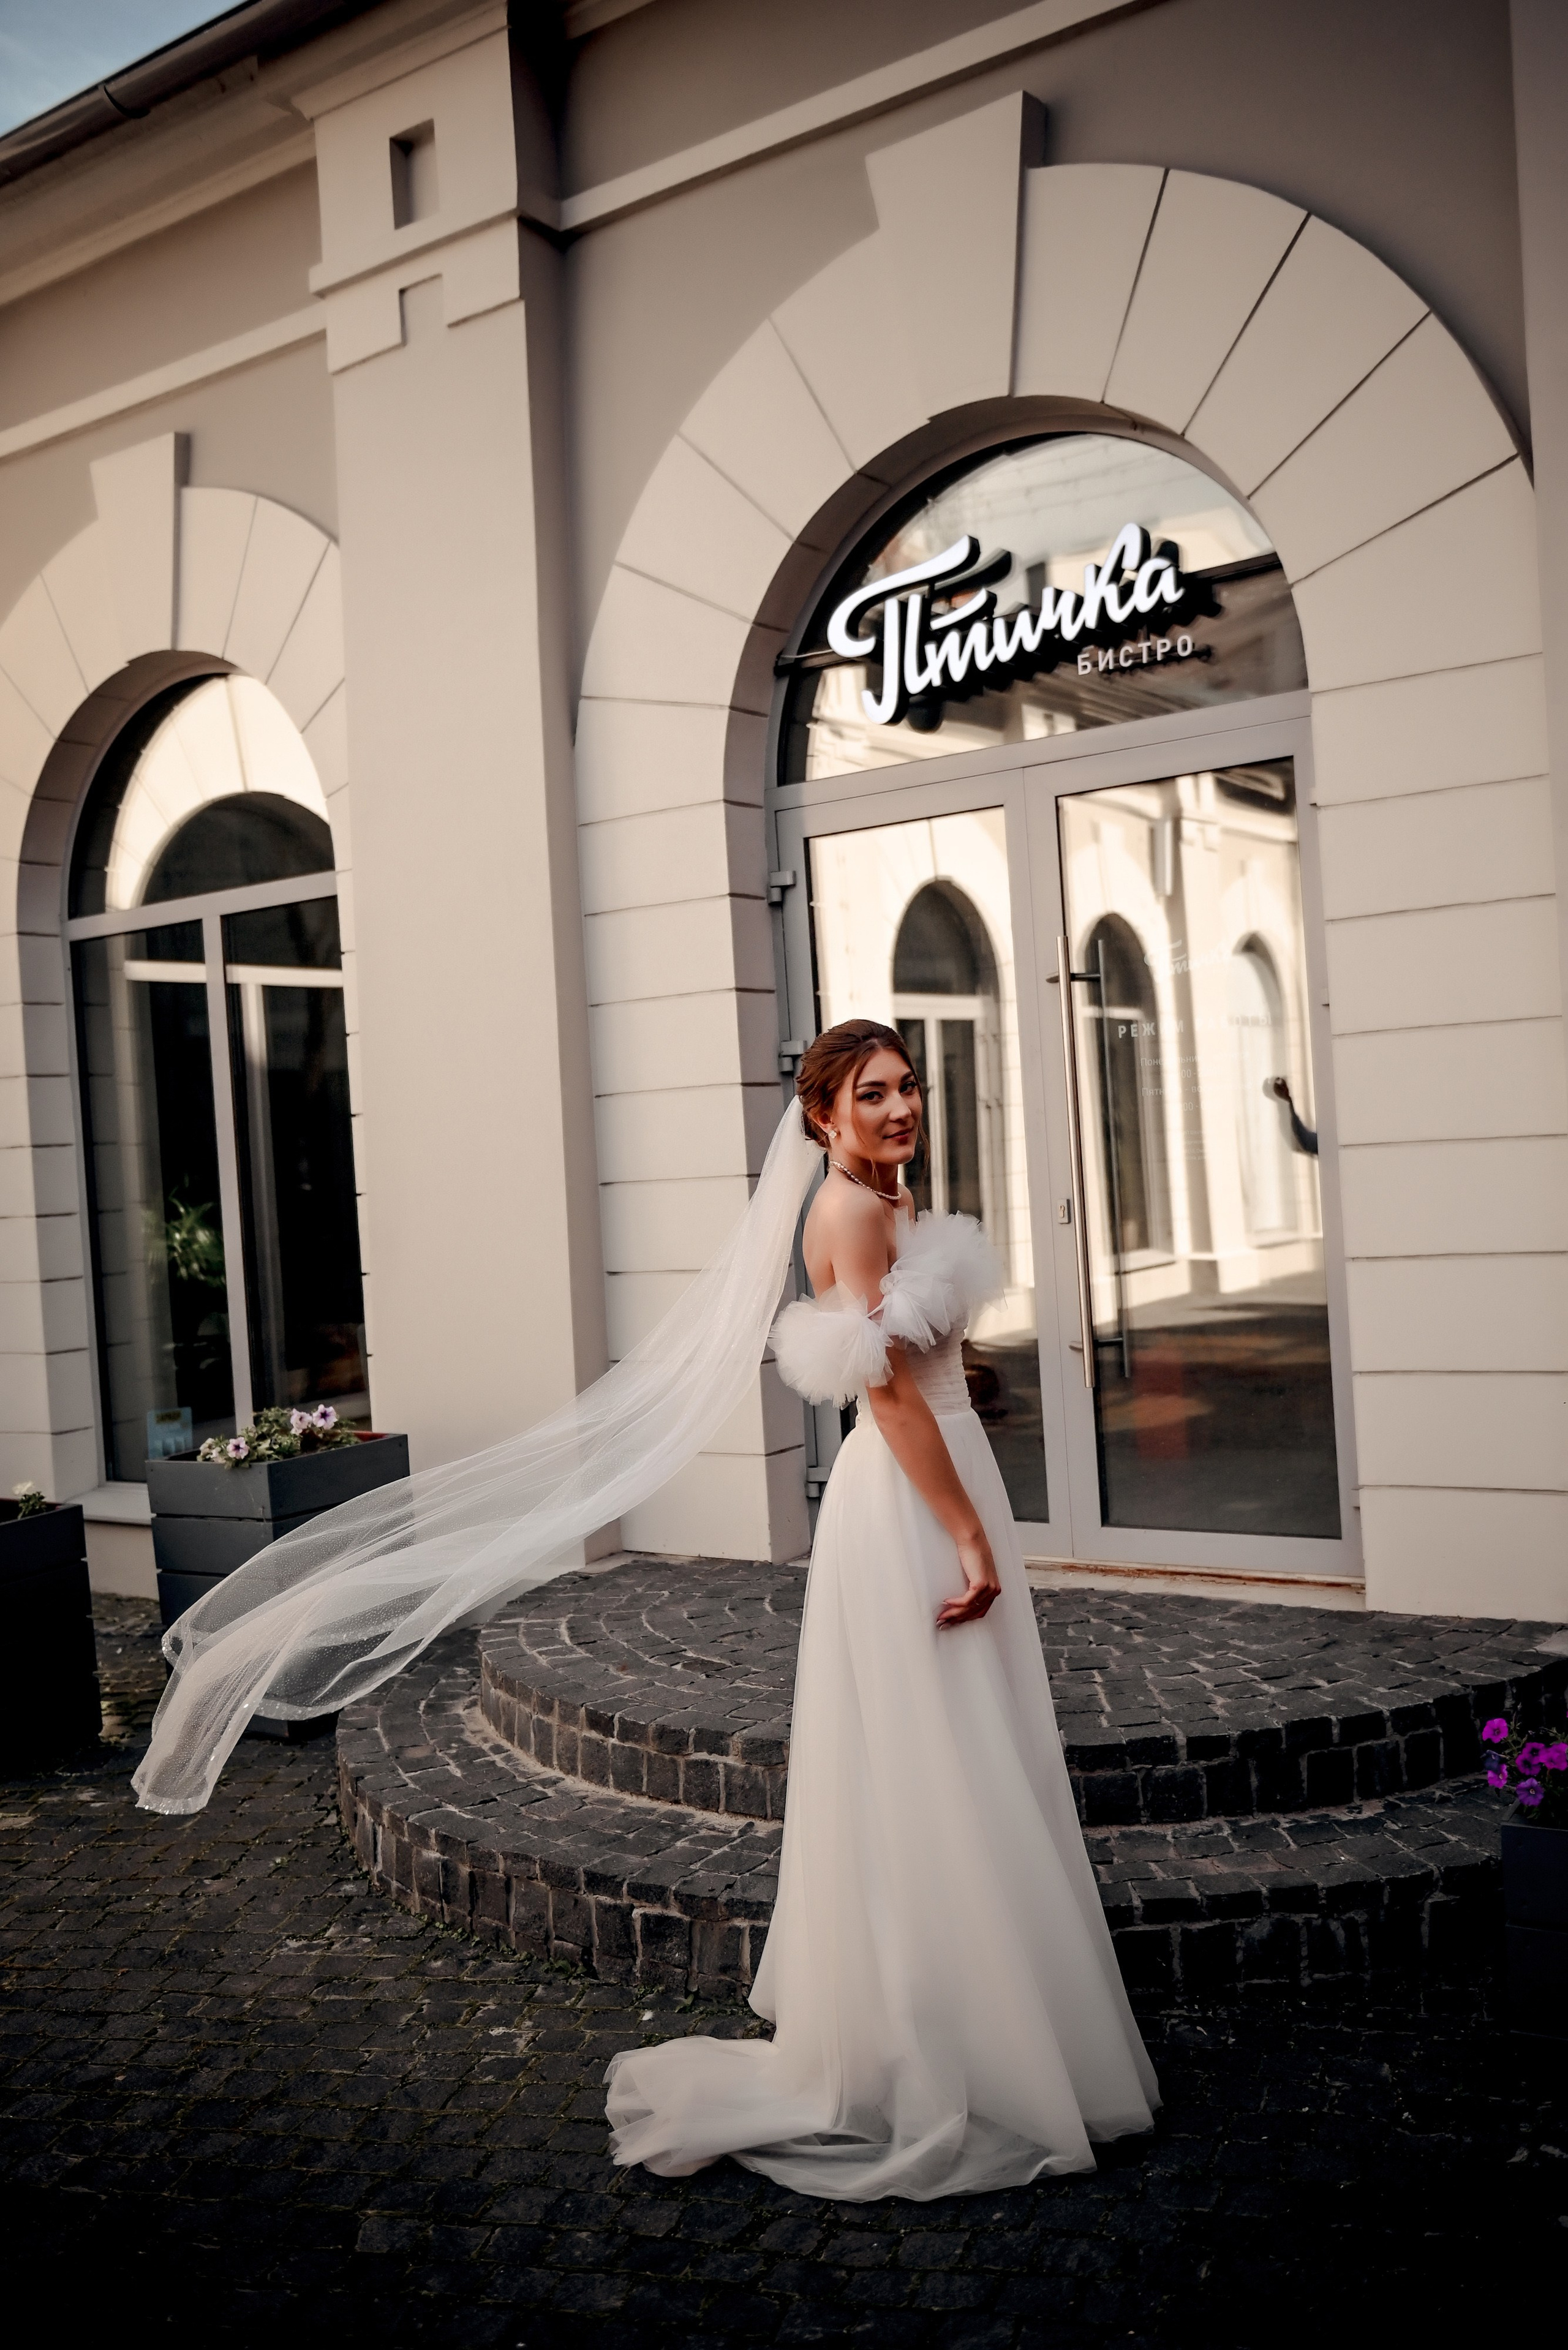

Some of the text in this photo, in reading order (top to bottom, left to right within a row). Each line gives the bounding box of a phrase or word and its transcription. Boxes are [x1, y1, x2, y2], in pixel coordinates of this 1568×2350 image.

[827, 523, 1185, 724] Птичка
[1077, 635, 1193, 676] БИСТРО
[1144, 940, 1232, 983] Птичк
[1118, 1020, 1184, 1039] РЕЖМ
